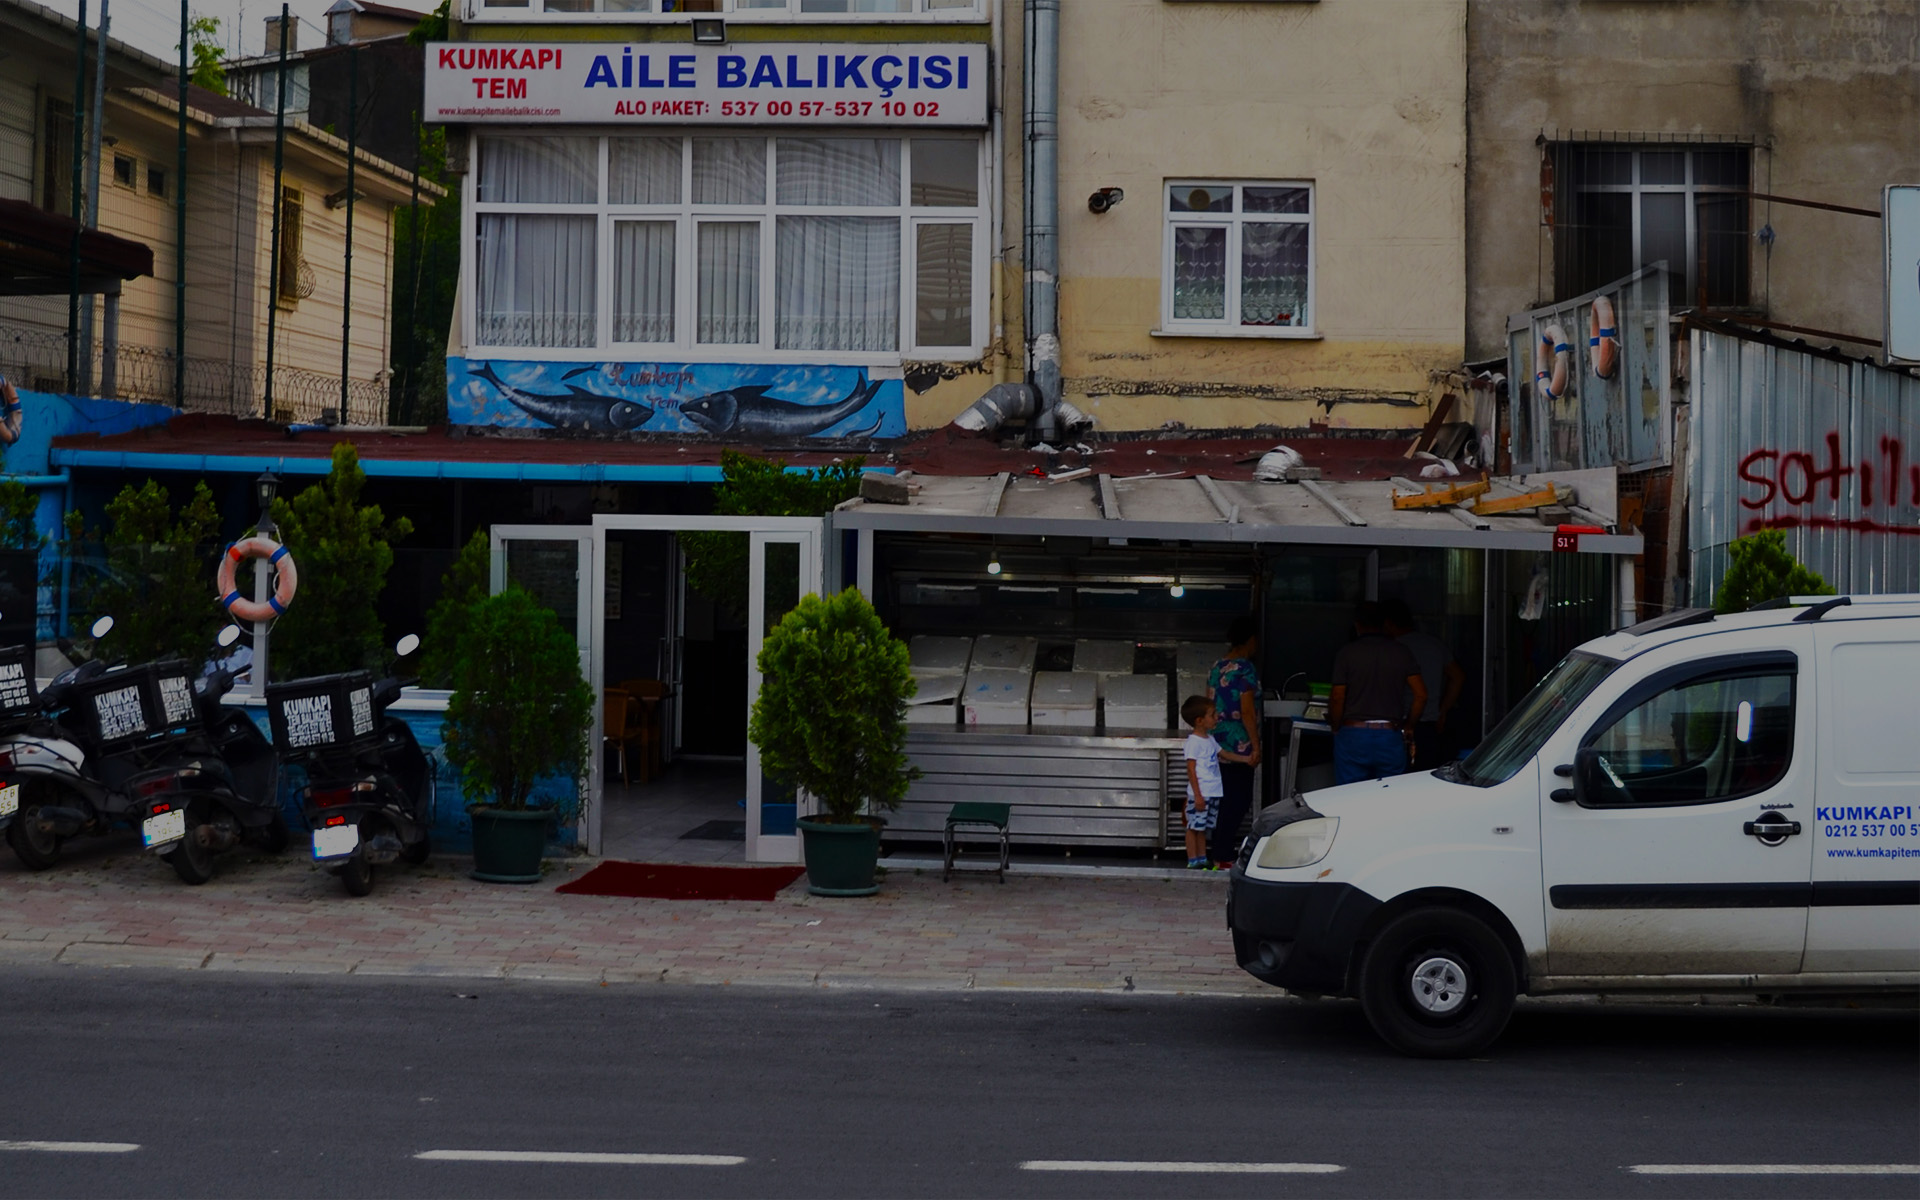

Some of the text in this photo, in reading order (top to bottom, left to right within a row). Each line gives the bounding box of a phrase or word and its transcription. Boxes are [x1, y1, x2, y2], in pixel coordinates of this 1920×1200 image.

[438, 48, 562, 70] KUMKAPI
[584, 45, 969, 98] AİLE BALIKÇISI
[472, 78, 528, 99] TEM
[614, 101, 647, 117] ALO
[652, 101, 709, 117] PAKET:
[720, 101, 760, 117] 537
[767, 101, 793, 117] 00
[881, 101, 907, 117] 10
[912, 101, 940, 117] 02
[94, 685, 141, 710] KUMKAPI
[283, 694, 331, 717] KUMKAPI
[1816, 806, 1912, 821] KUMKAPI
[1825, 824, 1857, 837] 0212
[1862, 824, 1886, 837] 537
[1889, 824, 1906, 837] 00
